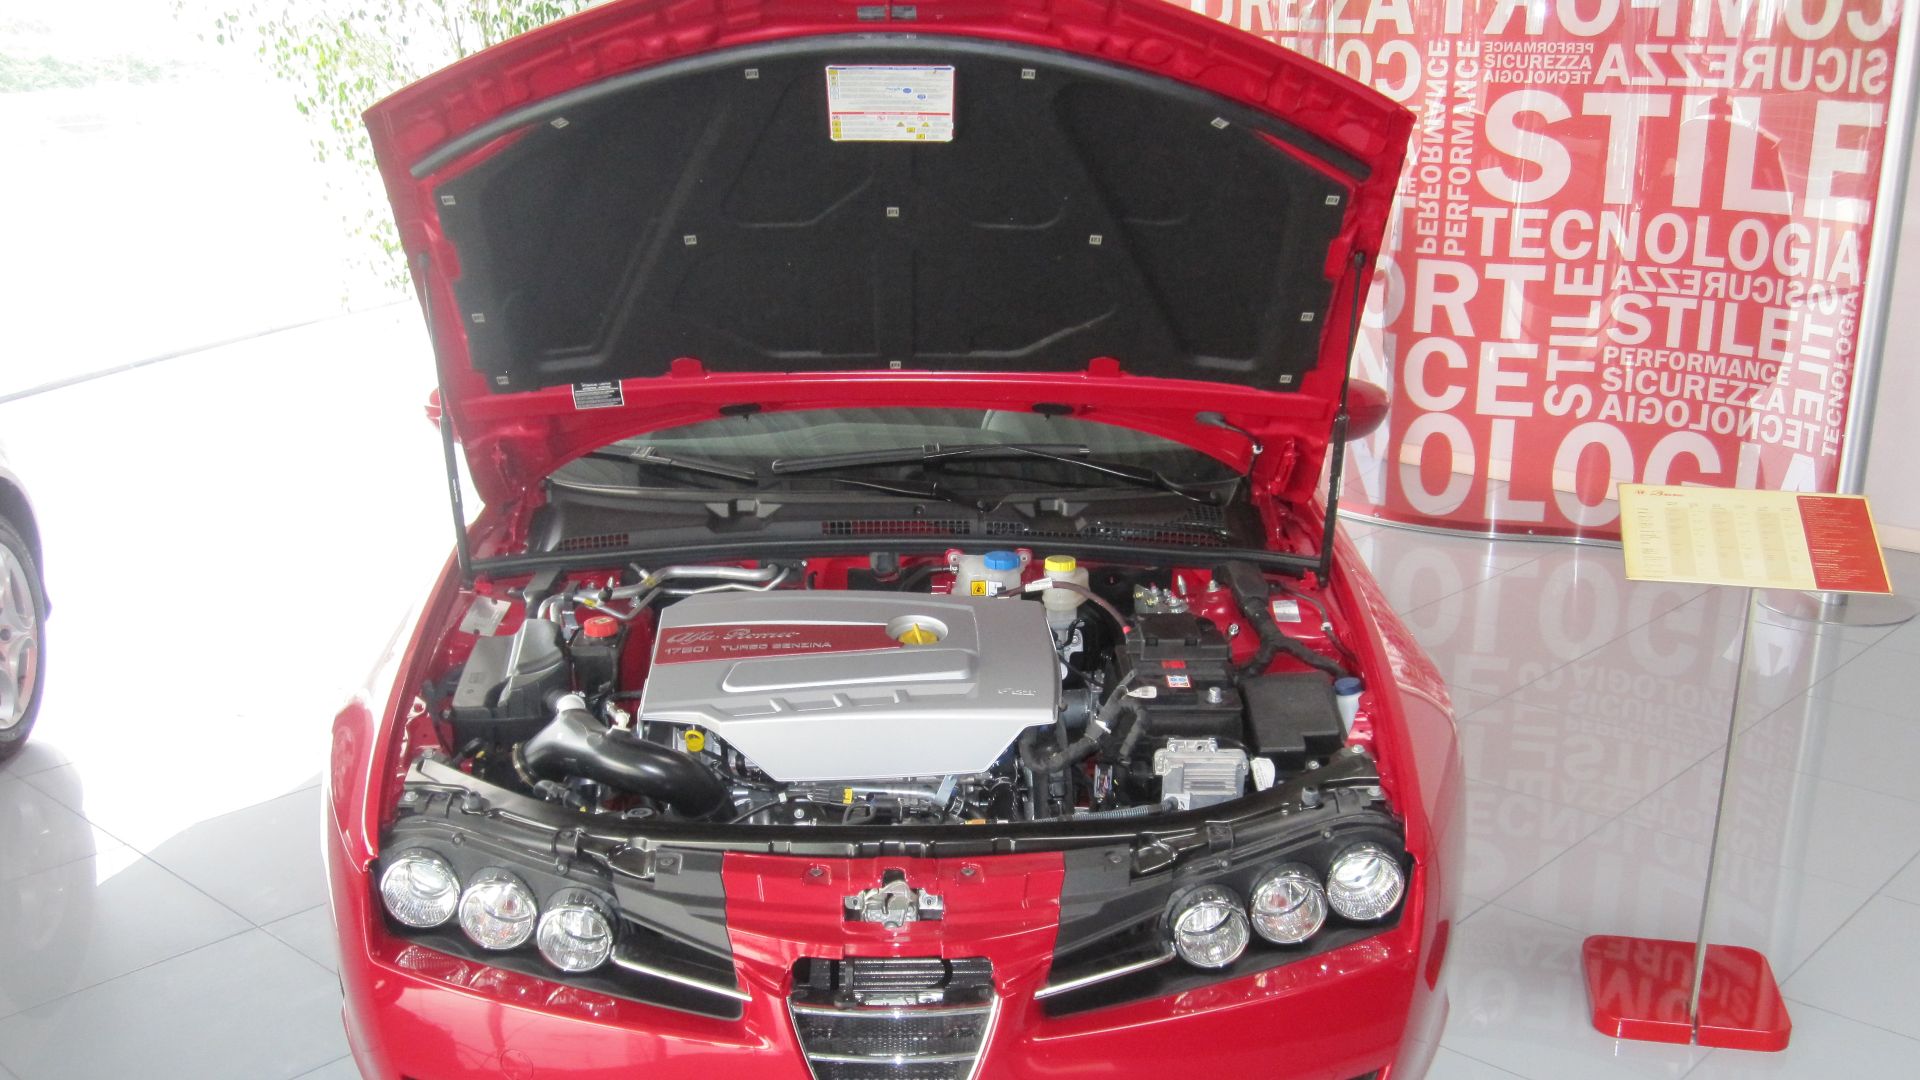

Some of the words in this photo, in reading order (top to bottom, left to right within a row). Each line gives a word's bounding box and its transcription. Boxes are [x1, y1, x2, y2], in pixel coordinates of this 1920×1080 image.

[1484, 54, 1592, 69] SICUREZZA
[1443, 40, 1480, 256] PERFORMANCE
[1476, 89, 1884, 225] STILE
[1472, 207, 1859, 286] TECNOLOGIA
[1543, 263, 1605, 419] STILE
[1606, 293, 1798, 363] STILE
[1601, 367, 1785, 414] SICUREZZA
[1602, 346, 1791, 386] PERFORMANCE
[1821, 289, 1858, 456] TECNOLOGIA
[772, 641, 832, 649] BENZINA
